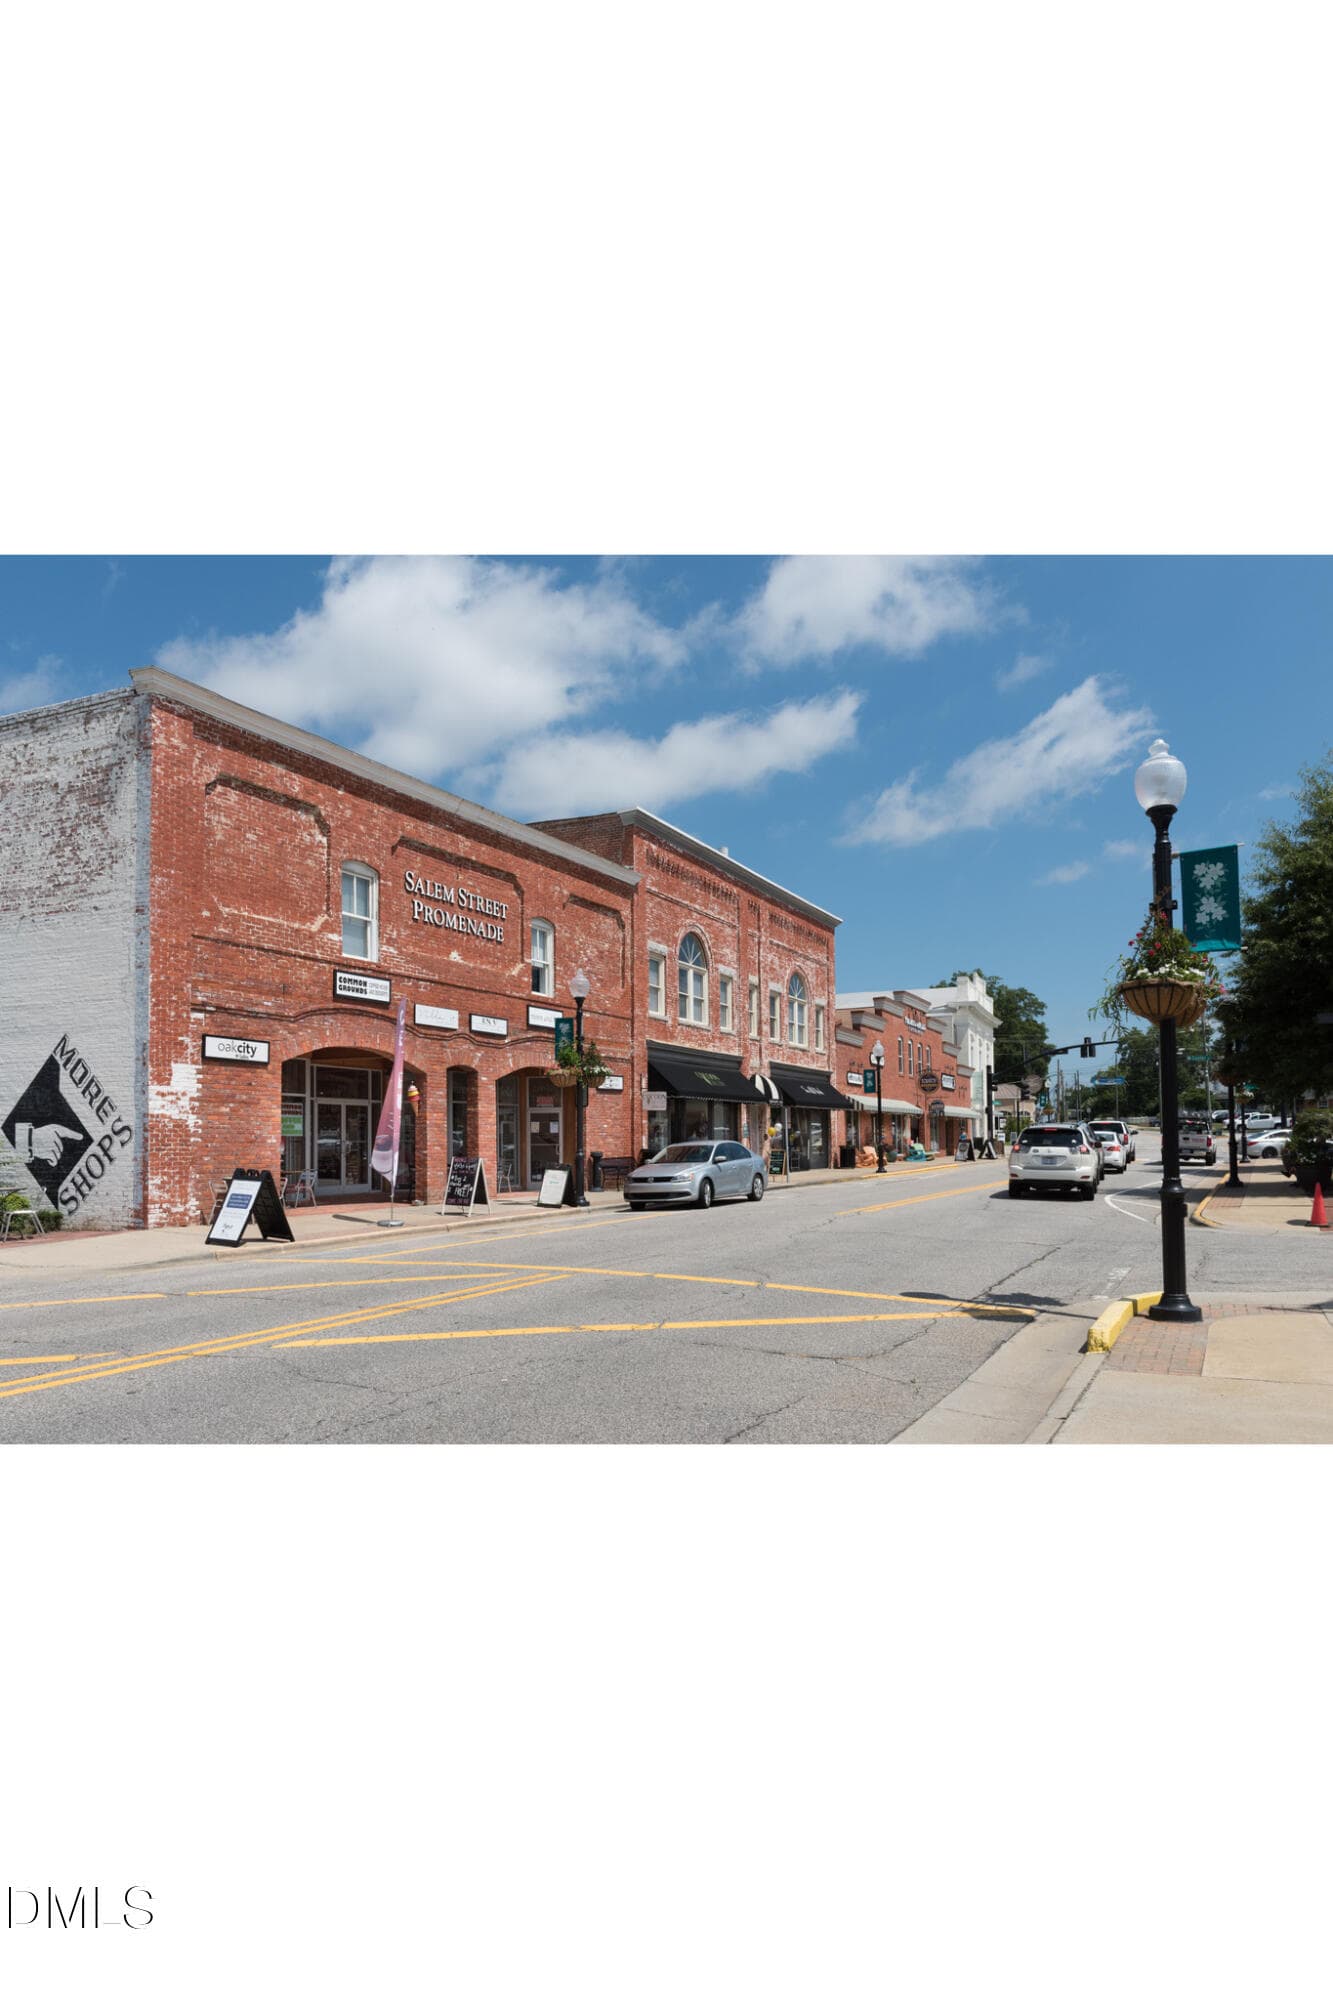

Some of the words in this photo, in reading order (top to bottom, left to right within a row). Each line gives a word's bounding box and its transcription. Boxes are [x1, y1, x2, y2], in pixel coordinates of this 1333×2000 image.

[405, 870, 455, 904] SALEM
[458, 887, 509, 919] STREET
[413, 899, 505, 942] PROMENADE
[338, 976, 368, 987] COMMON
[338, 984, 368, 995] GROUNDS
[53, 1033, 118, 1125] MORE
[59, 1115, 134, 1215] SHOPS
